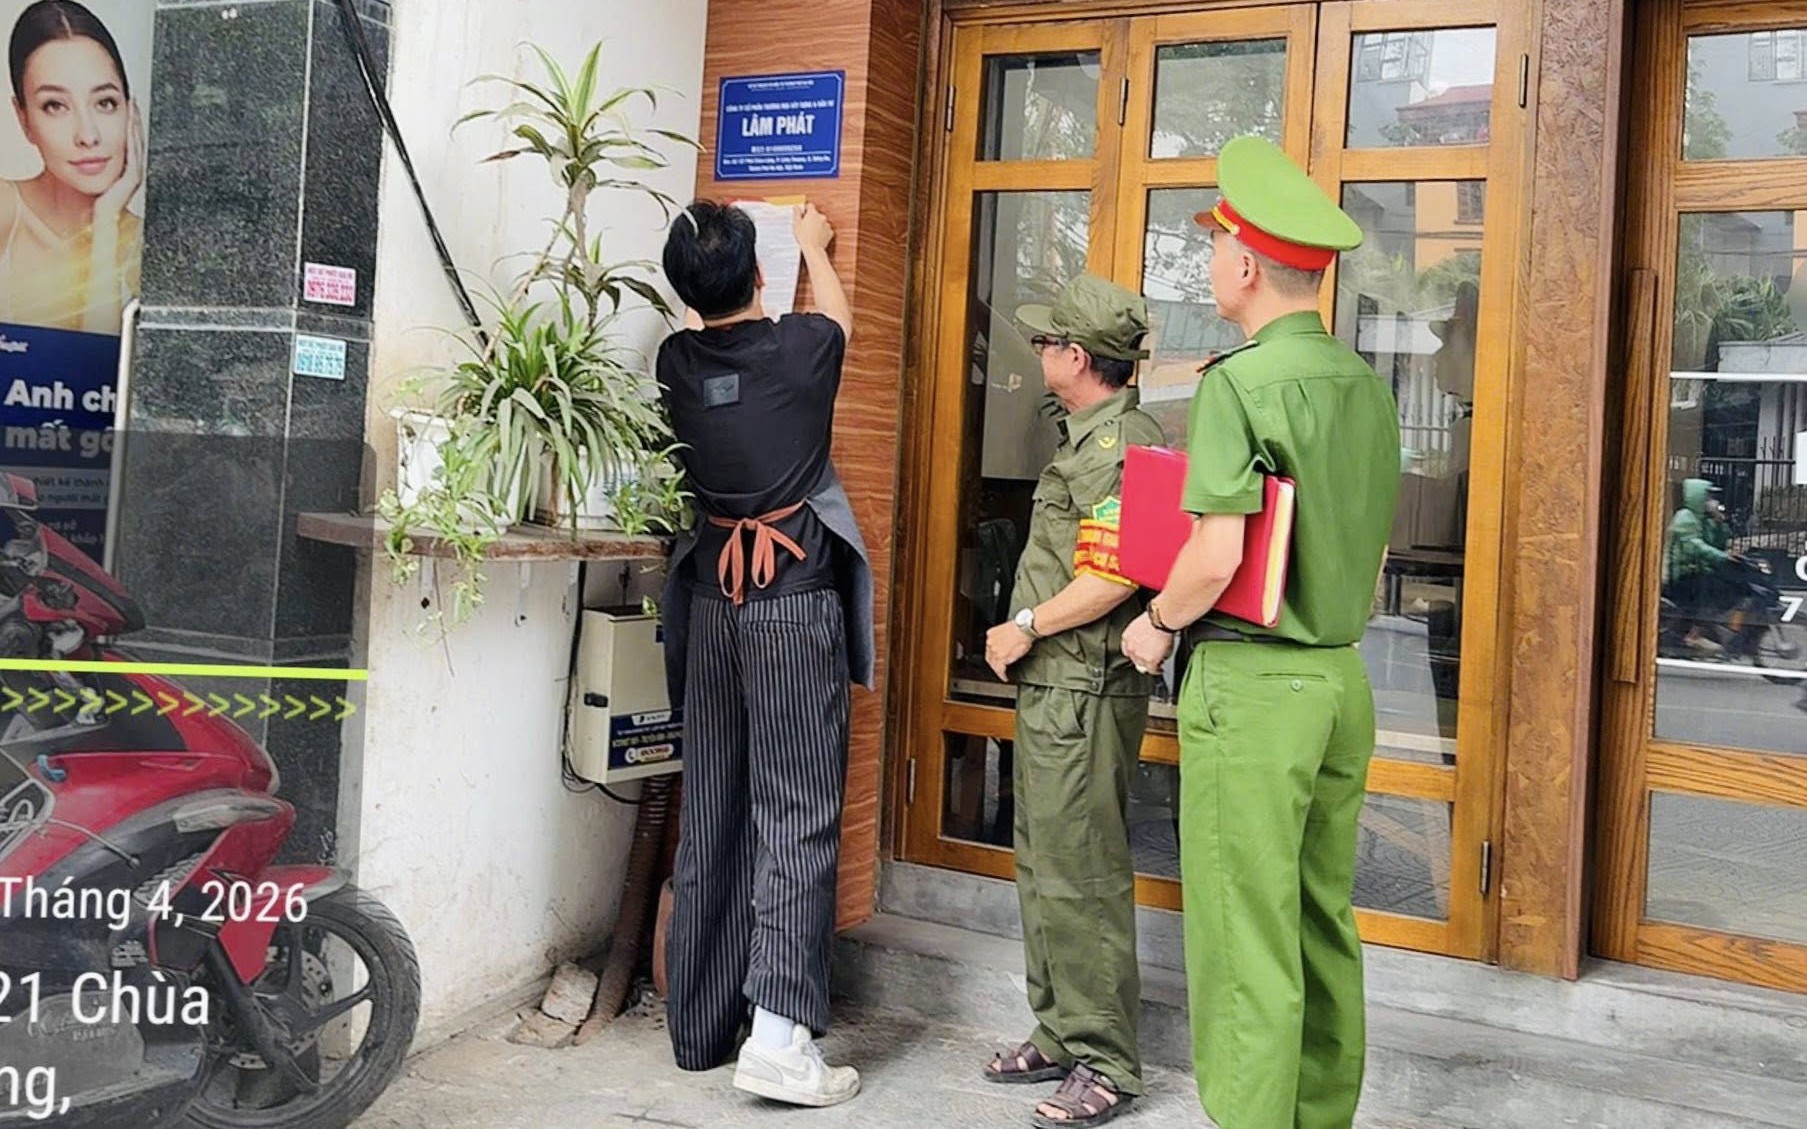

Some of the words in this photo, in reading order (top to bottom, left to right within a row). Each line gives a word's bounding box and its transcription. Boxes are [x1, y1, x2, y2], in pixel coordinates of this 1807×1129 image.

[742, 113, 773, 137] LÂM
[776, 111, 815, 135] PHÁT
[4, 379, 73, 410] Anh
[5, 419, 71, 450] mất
